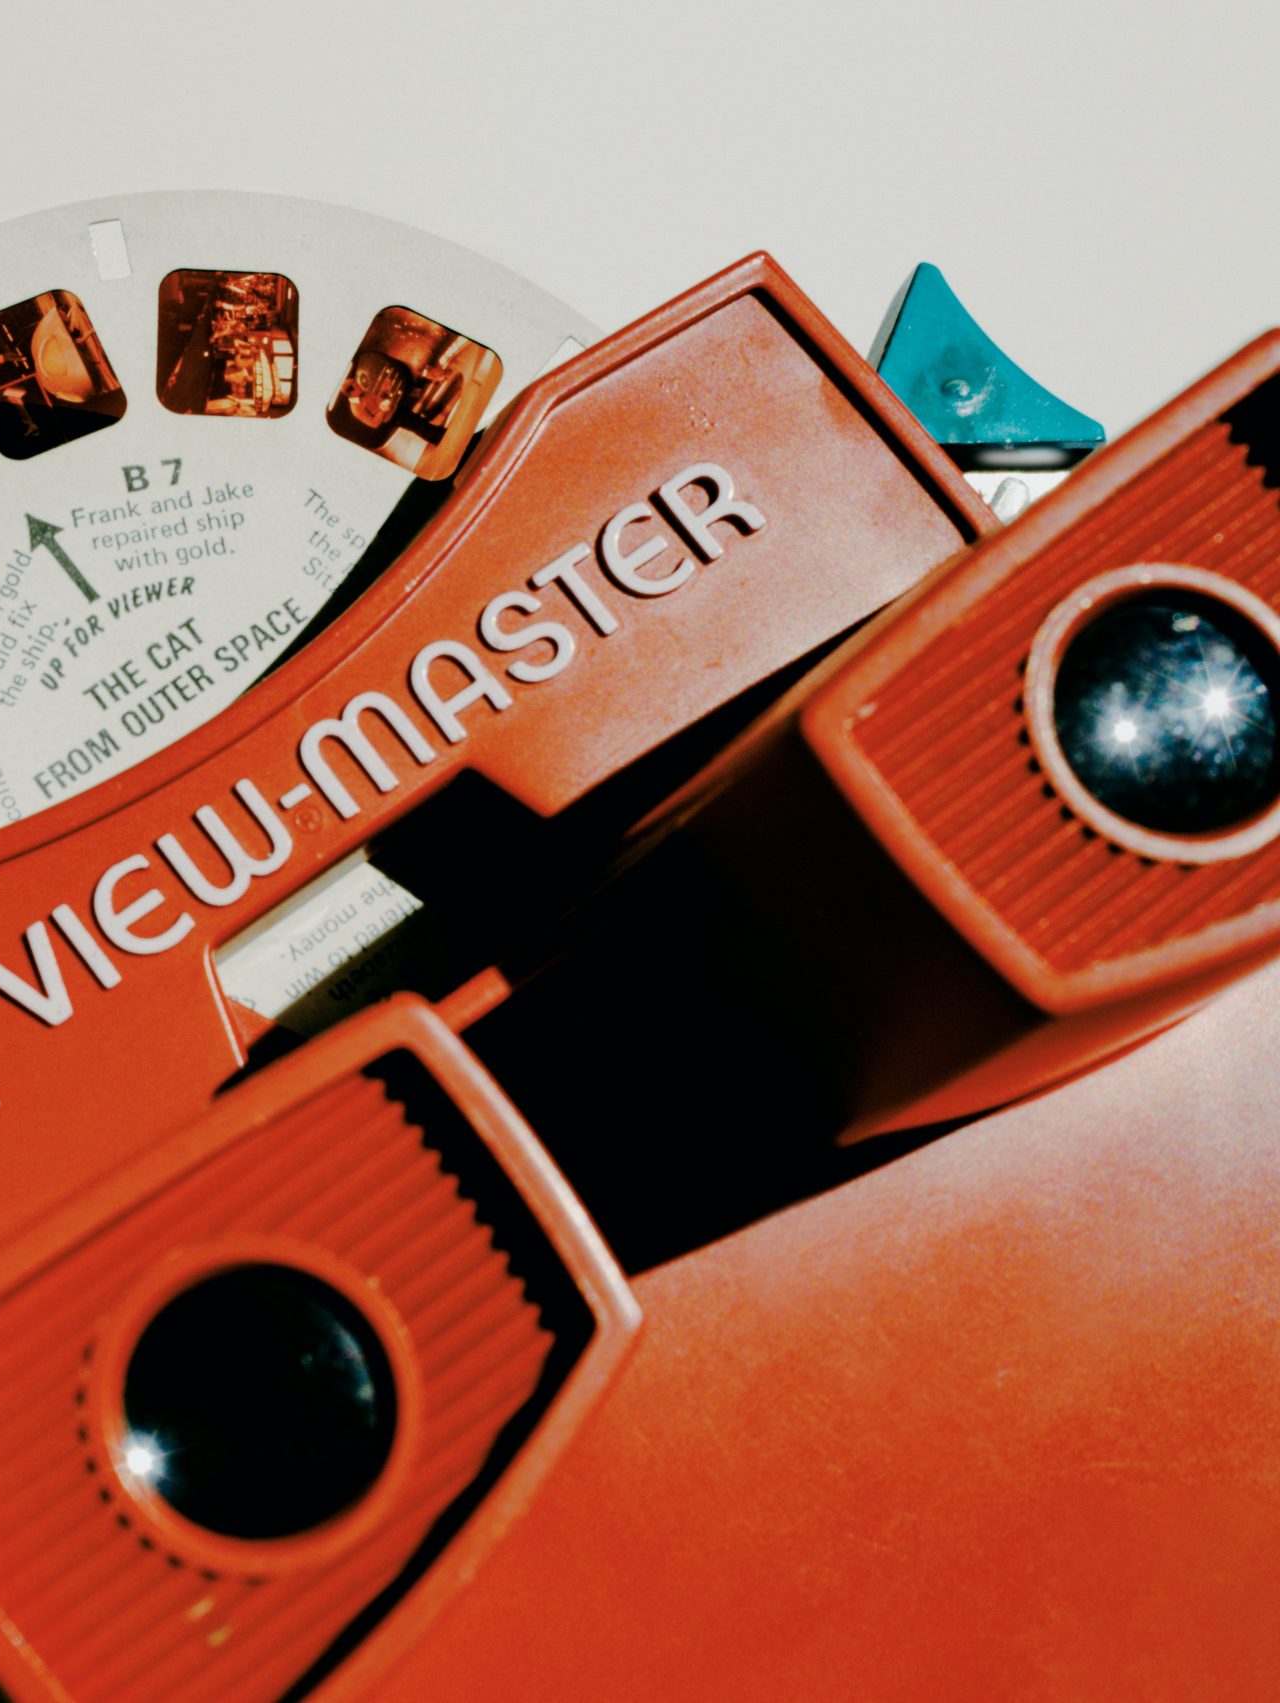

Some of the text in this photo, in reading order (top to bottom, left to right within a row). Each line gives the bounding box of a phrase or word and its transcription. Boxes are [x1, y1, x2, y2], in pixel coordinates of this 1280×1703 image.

[121, 457, 183, 493] B 7
[71, 483, 255, 528] Frank and Jake
[303, 487, 367, 550] The sp
[91, 509, 245, 550] repaired ship
[308, 529, 342, 561] the
[0, 549, 32, 600] gold
[114, 536, 236, 572] with gold.
[7, 600, 38, 629] fix
[40, 576, 196, 691] UP FOR VIEWER
[21, 621, 59, 670] ship.
[82, 617, 204, 711] THE CAT
[32, 597, 309, 800] FROM OUTER SPACE
[280, 902, 358, 962] money.
[285, 964, 327, 1000] win
